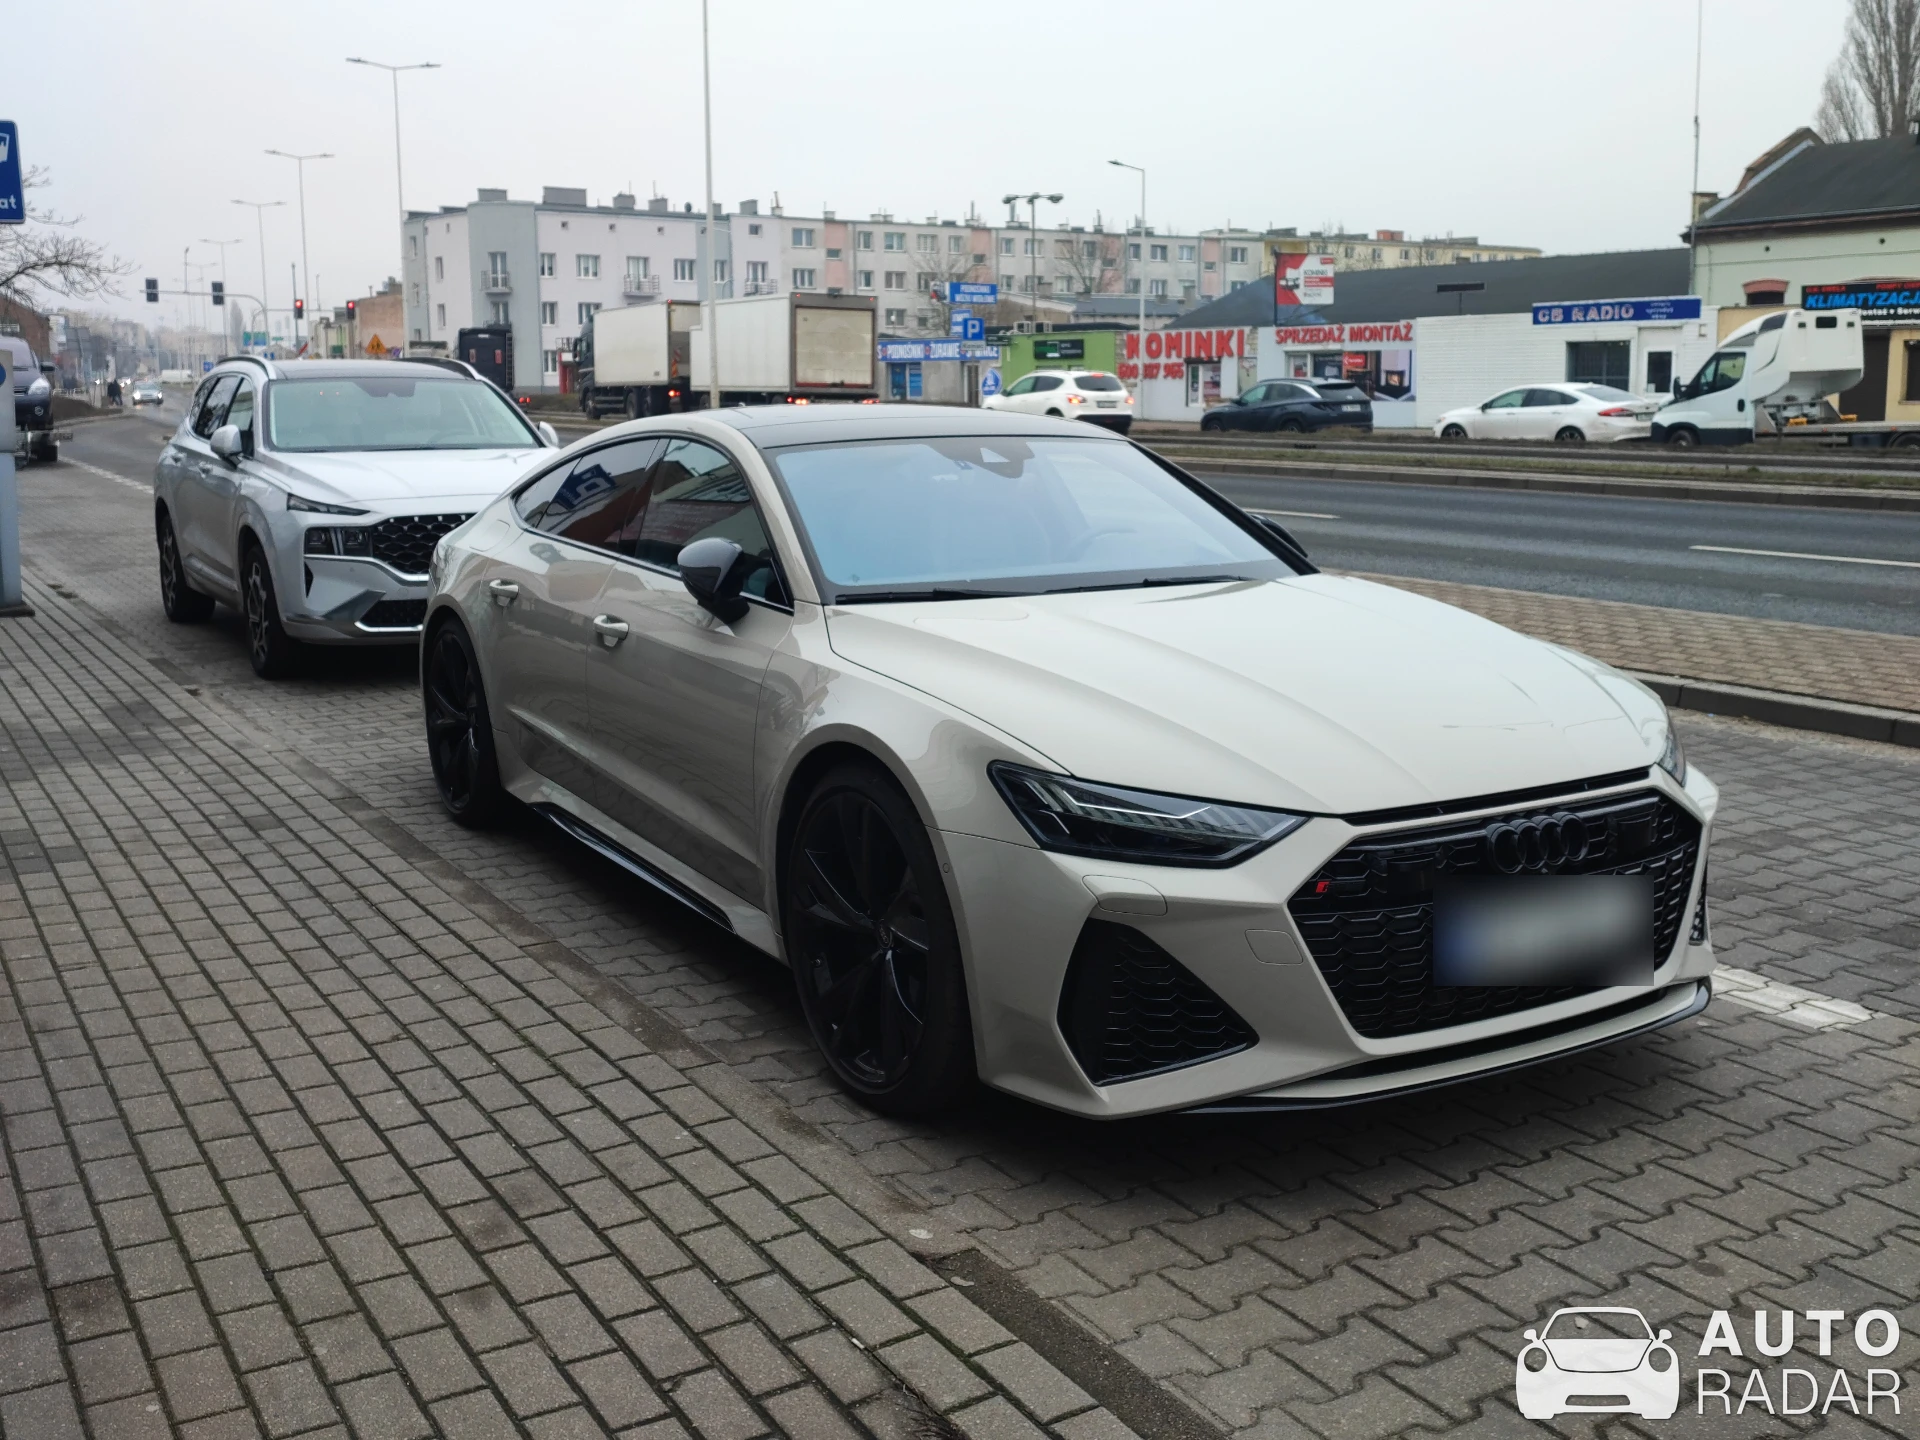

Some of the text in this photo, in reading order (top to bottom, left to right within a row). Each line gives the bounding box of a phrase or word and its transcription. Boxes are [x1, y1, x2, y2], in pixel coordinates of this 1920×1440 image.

[1805, 289, 1920, 309] KLIMATYZACJ
[1538, 307, 1564, 323] CB
[1571, 304, 1634, 321] RADIO
[1858, 307, 1888, 316] ontaż
[967, 320, 980, 338] P
[1275, 322, 1412, 344] SPRZEDAŻ MONTAŻ
[1125, 329, 1245, 359] KOMINKI
